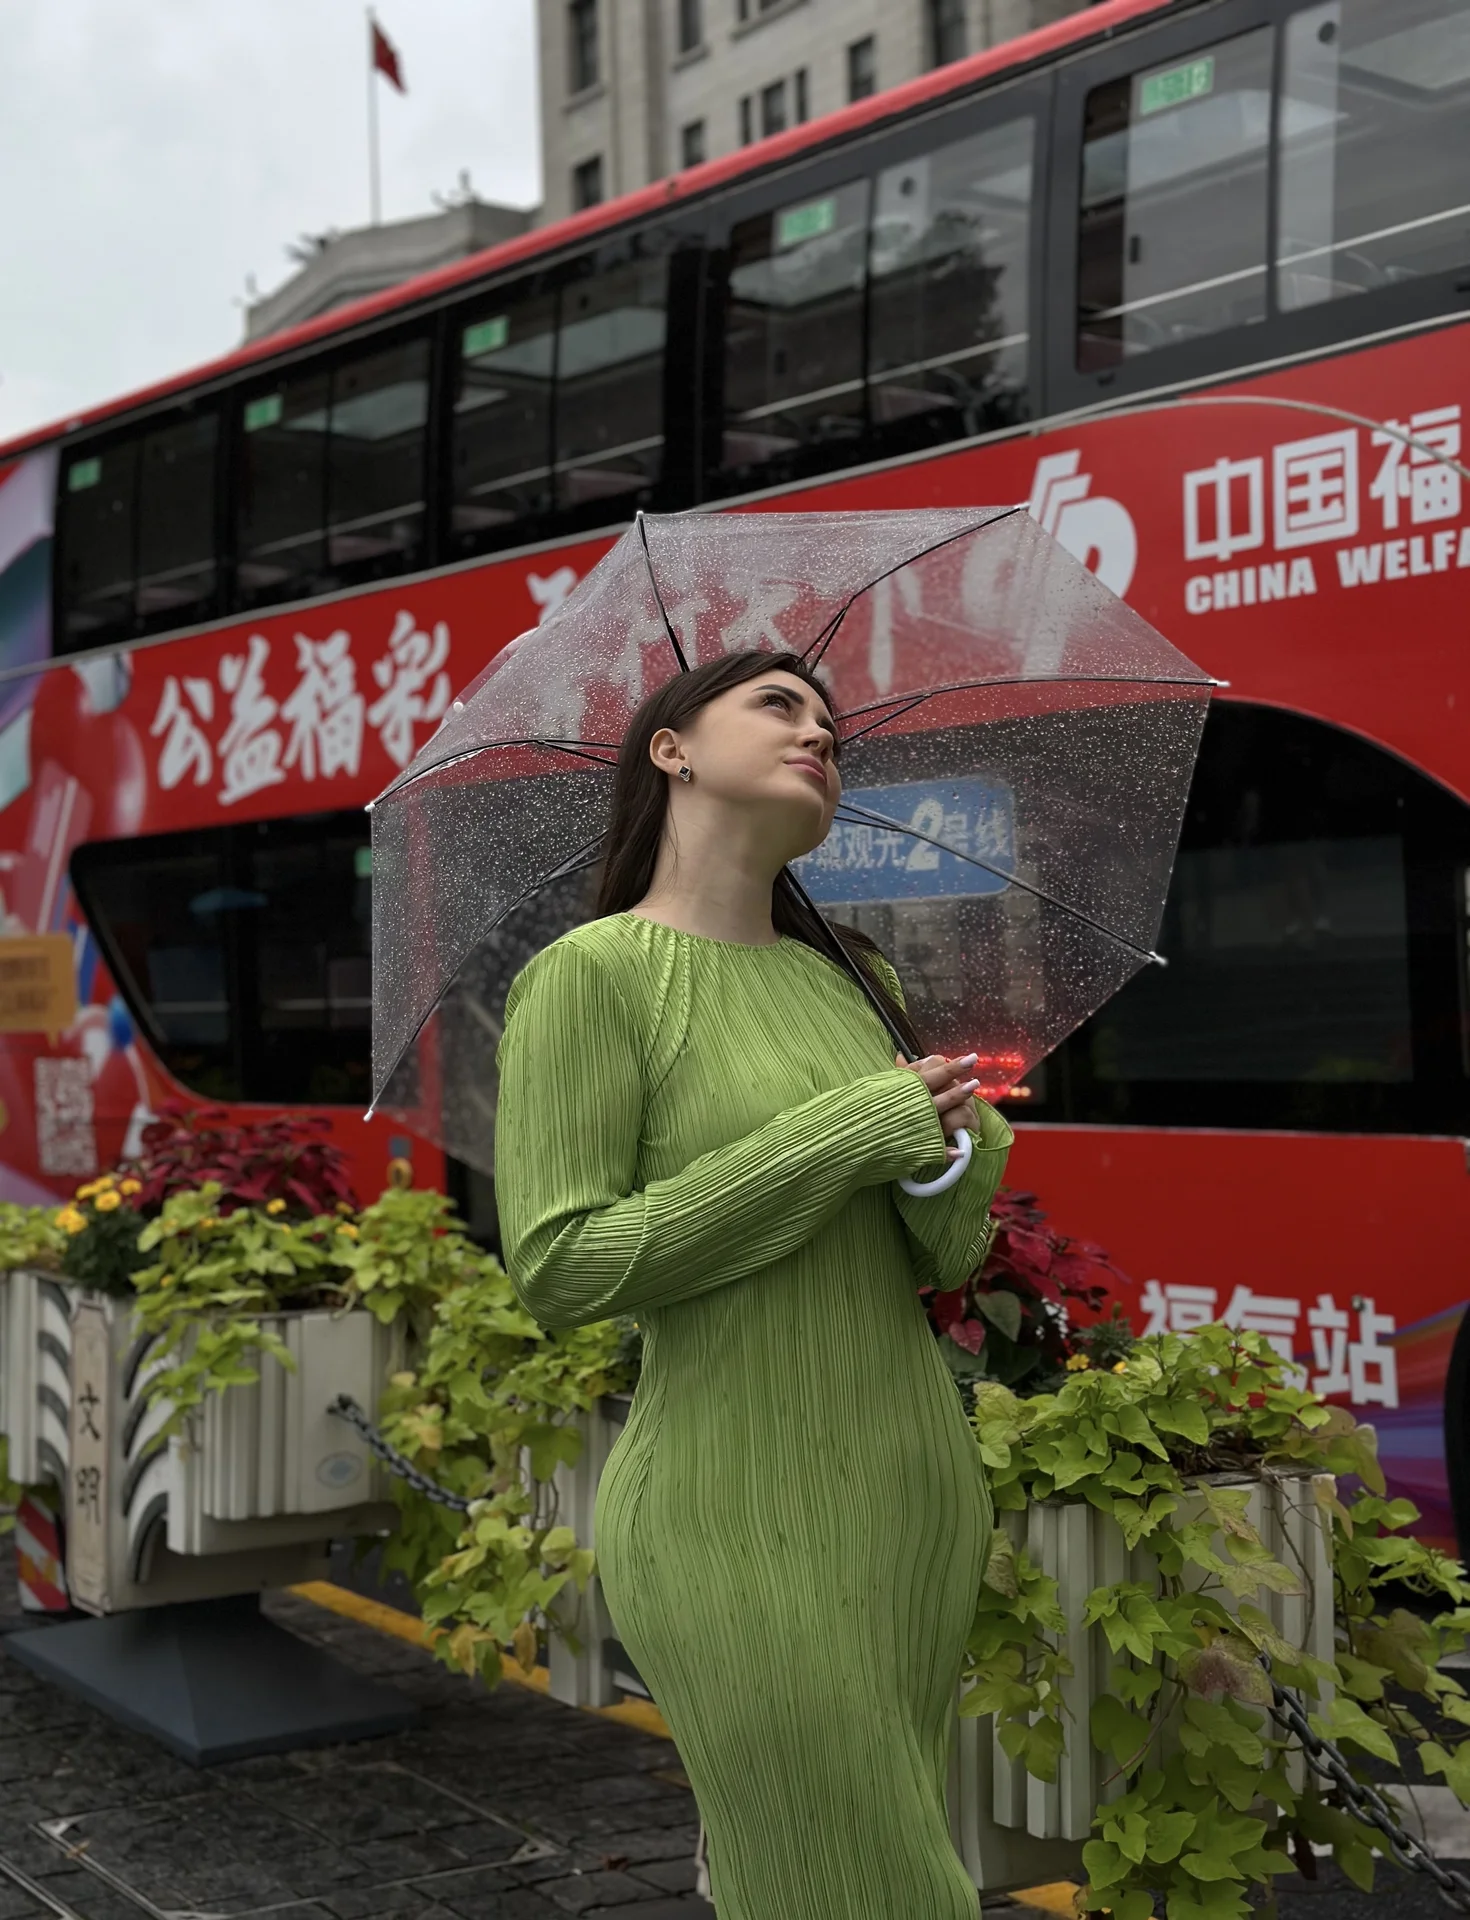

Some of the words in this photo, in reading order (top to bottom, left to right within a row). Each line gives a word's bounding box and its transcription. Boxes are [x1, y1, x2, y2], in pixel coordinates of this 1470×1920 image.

[1183, 404, 1462, 562] 中国福
[1184, 556, 1317, 615] CHINA
[152, 611, 450, 805] 公益福彩
